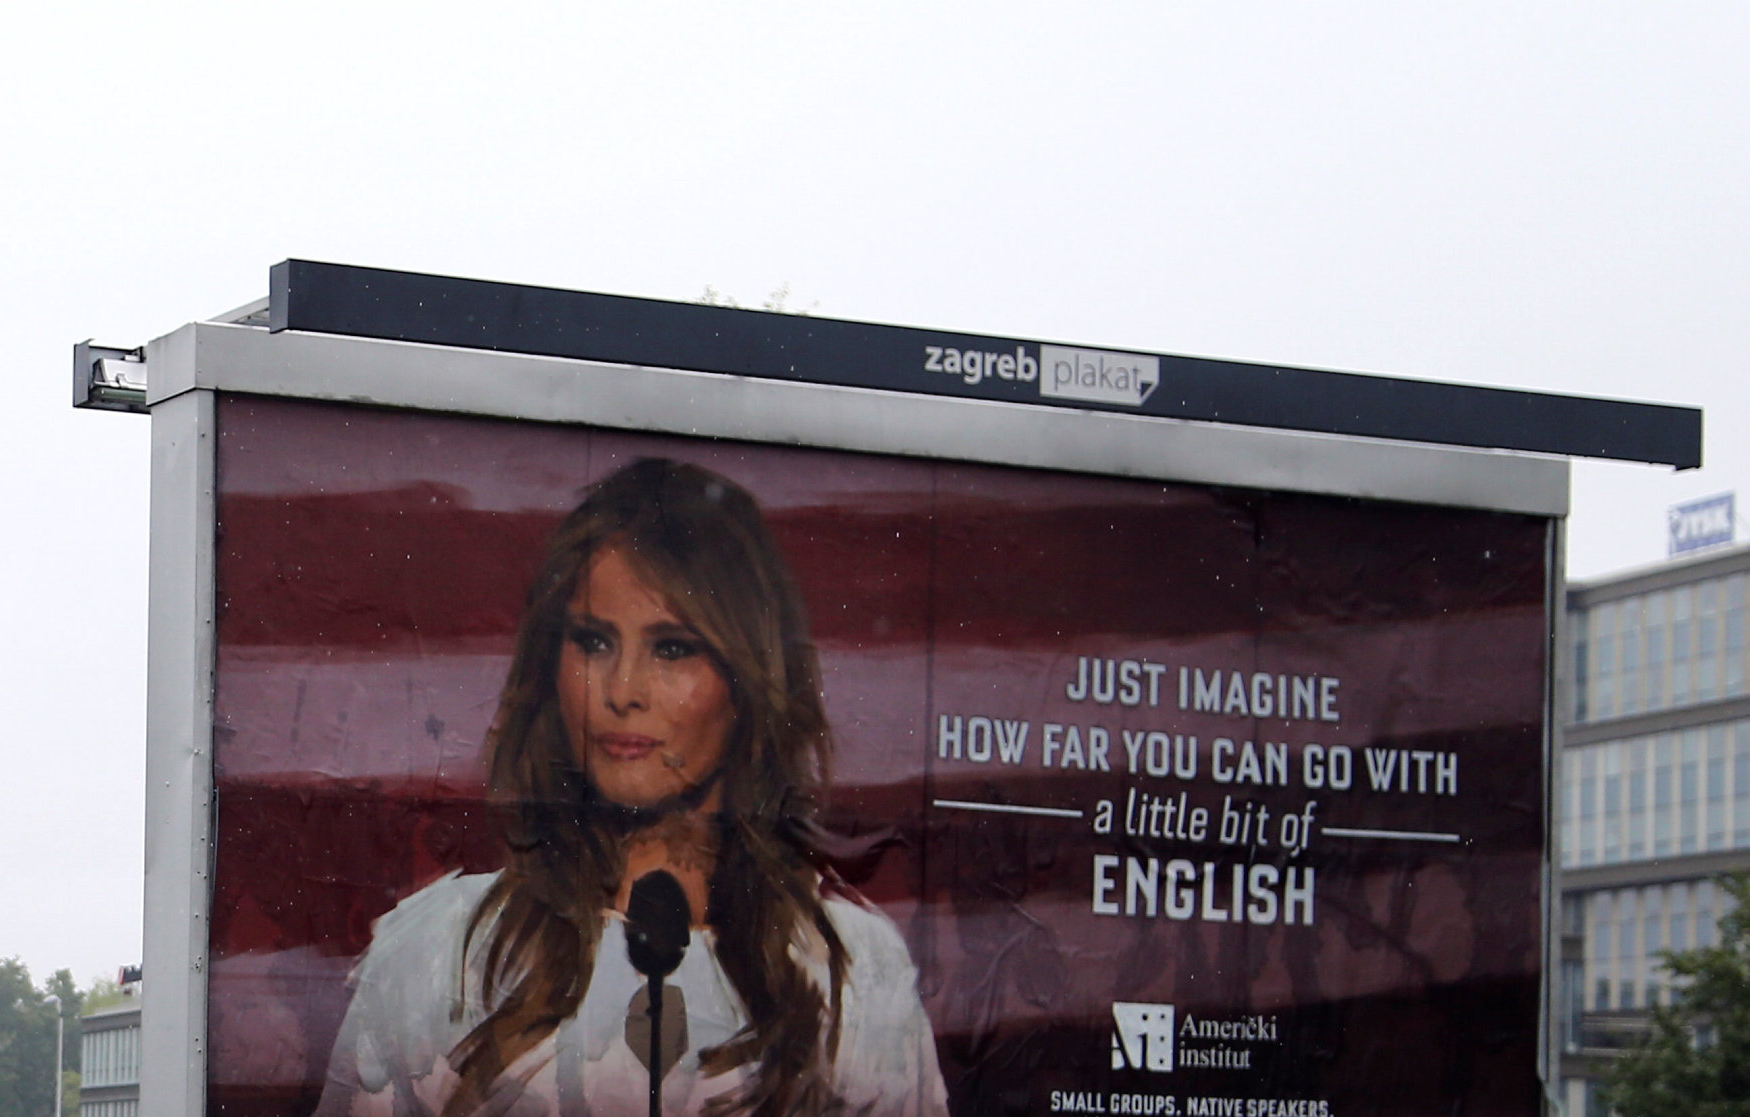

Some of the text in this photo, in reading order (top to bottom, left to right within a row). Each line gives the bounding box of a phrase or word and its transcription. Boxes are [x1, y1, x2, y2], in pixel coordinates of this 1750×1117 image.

[923, 345, 1143, 393] zagreb plakat
[1065, 656, 1341, 722] JUST IMAGINE
[937, 713, 1459, 797] HOW FAR YOU CAN GO WITH
[1092, 786, 1318, 858] a little bit of
[1091, 853, 1316, 926] ENGLISH
[1178, 1041, 1251, 1070] institut
[1179, 1013, 1278, 1041] Američki
[1050, 1090, 1106, 1113] SMALL
[1110, 1093, 1182, 1117] GROUPS.
[1186, 1096, 1244, 1117] NATIVE
